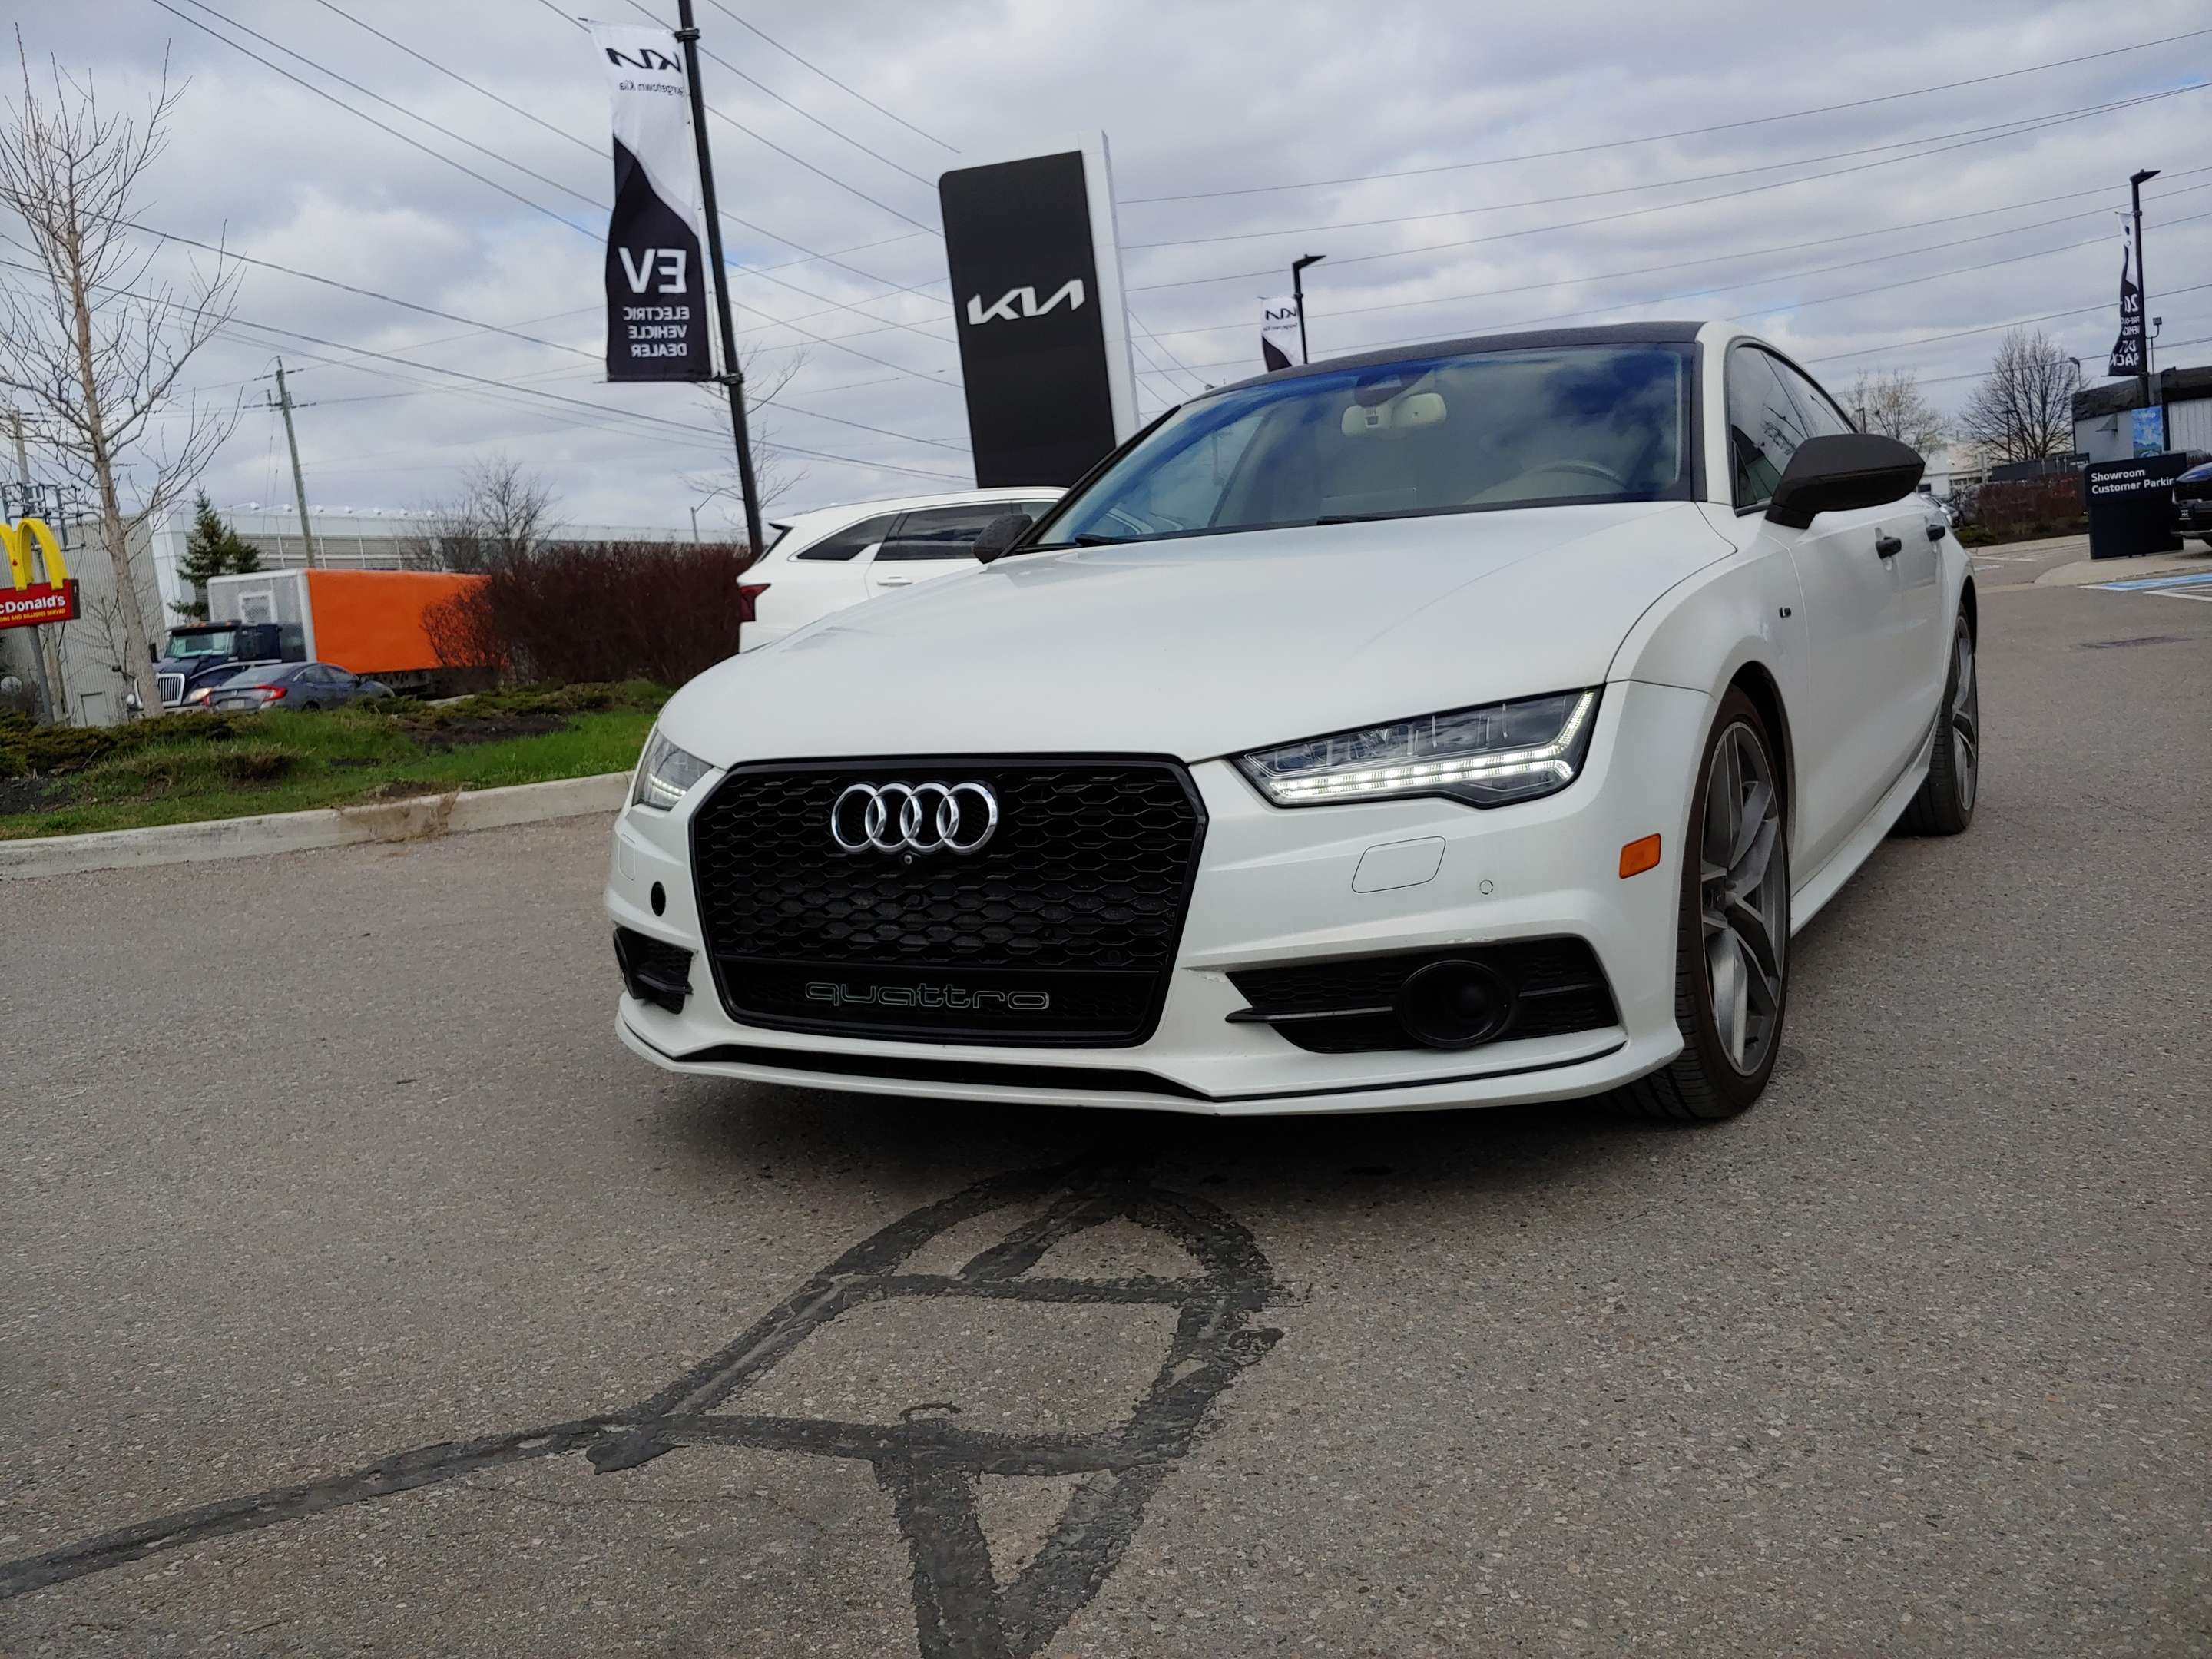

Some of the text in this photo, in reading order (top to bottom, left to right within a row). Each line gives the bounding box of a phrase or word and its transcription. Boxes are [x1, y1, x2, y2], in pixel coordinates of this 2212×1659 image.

[967, 279, 1085, 326] KIA
[2091, 469, 2145, 482] Showroom
[2091, 476, 2175, 495] Customer Parkin
[0, 595, 66, 614] cDonald's
[805, 981, 1050, 1010] quattro
